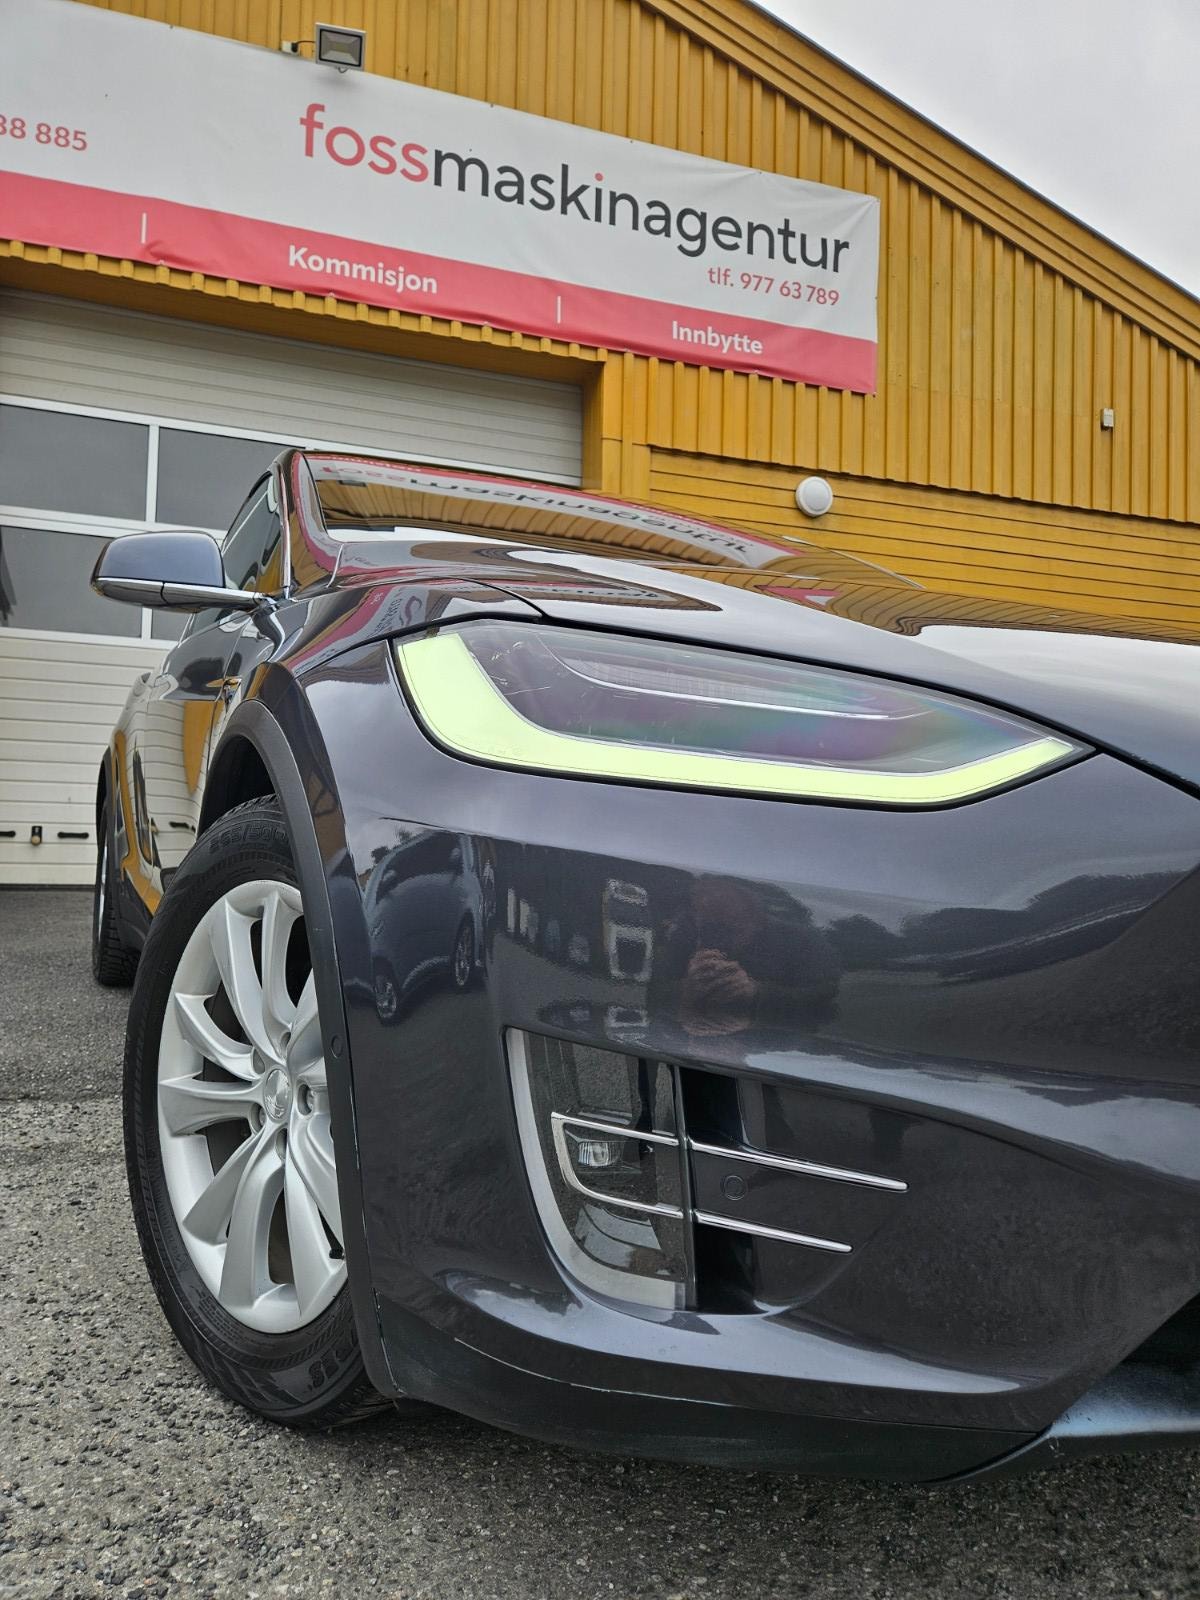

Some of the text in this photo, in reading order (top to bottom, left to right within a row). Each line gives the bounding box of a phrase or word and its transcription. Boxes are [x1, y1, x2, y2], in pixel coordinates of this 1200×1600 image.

[35, 122, 88, 152] 885
[298, 102, 850, 273] fossmaskinagentur
[288, 244, 438, 295] Kommisjon
[707, 266, 840, 307] tlf. 977 63 789
[671, 320, 763, 355] Innbytte
